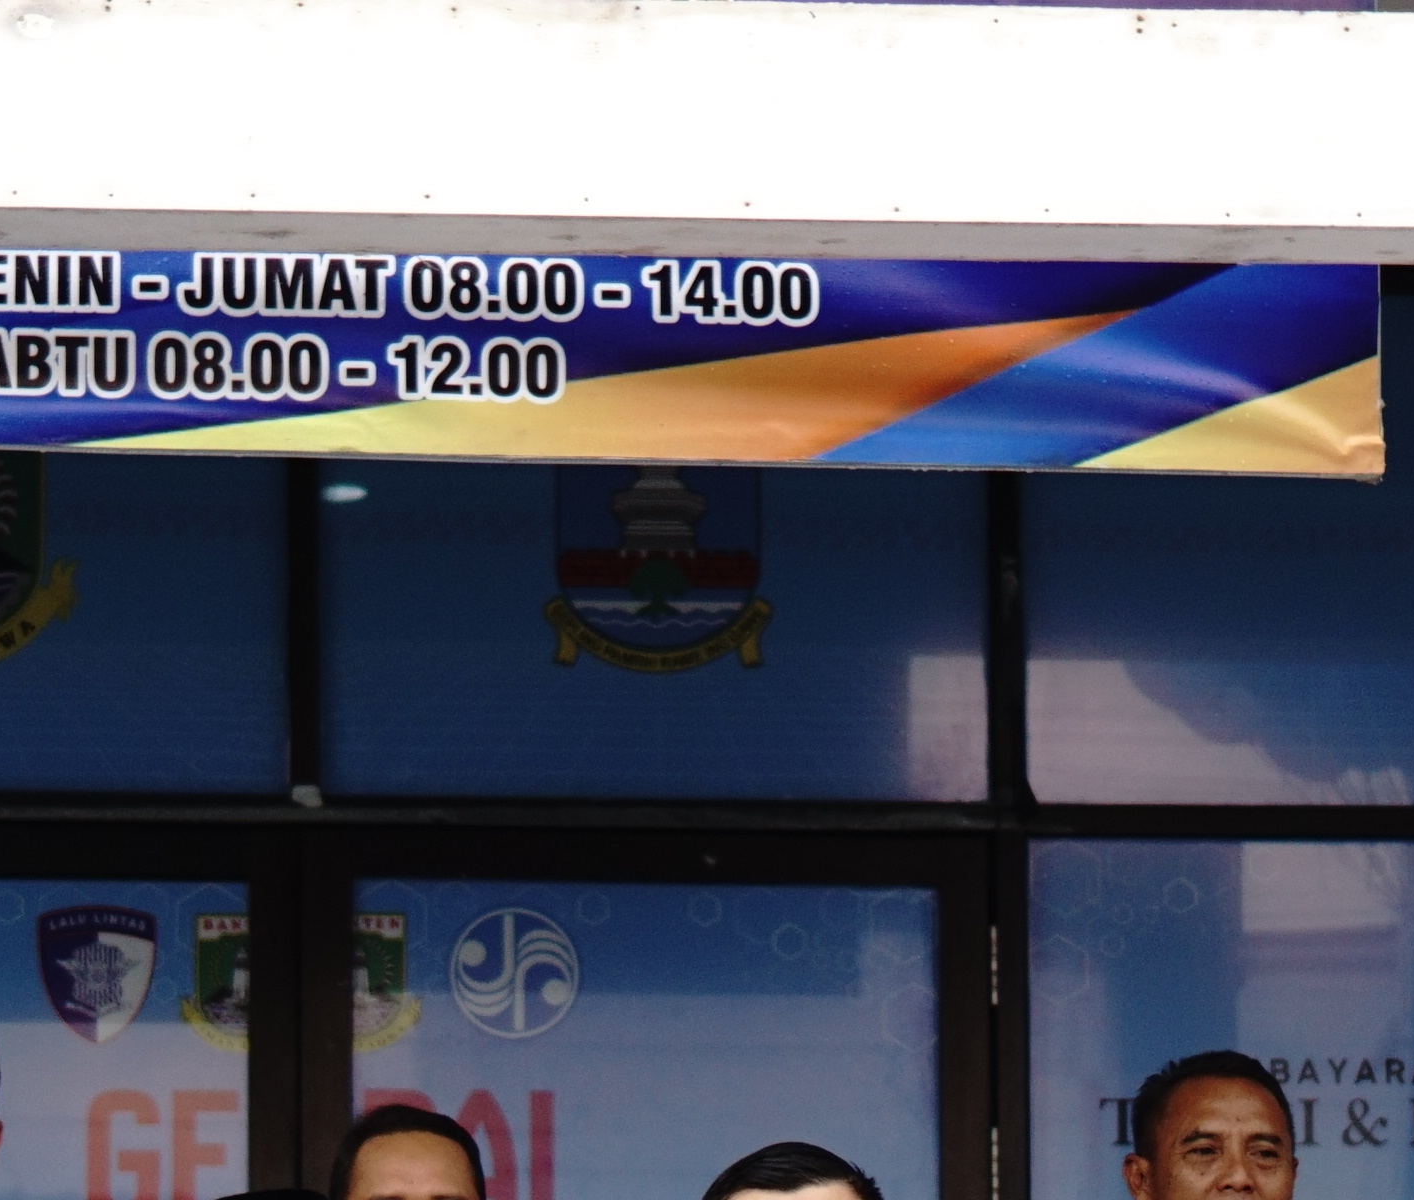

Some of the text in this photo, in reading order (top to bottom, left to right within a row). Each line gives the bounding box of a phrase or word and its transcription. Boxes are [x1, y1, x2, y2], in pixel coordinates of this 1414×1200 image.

[134, 275, 169, 302] -
[183, 252, 390, 318] JUMAT
[408, 258, 582, 320] 08.00
[595, 281, 630, 308] -
[644, 260, 819, 324] 14.00
[150, 331, 329, 399] 08.00
[341, 359, 375, 387] -
[392, 335, 565, 401] 12.00
[49, 914, 86, 930] LALU
[1342, 1098, 1386, 1147] &
